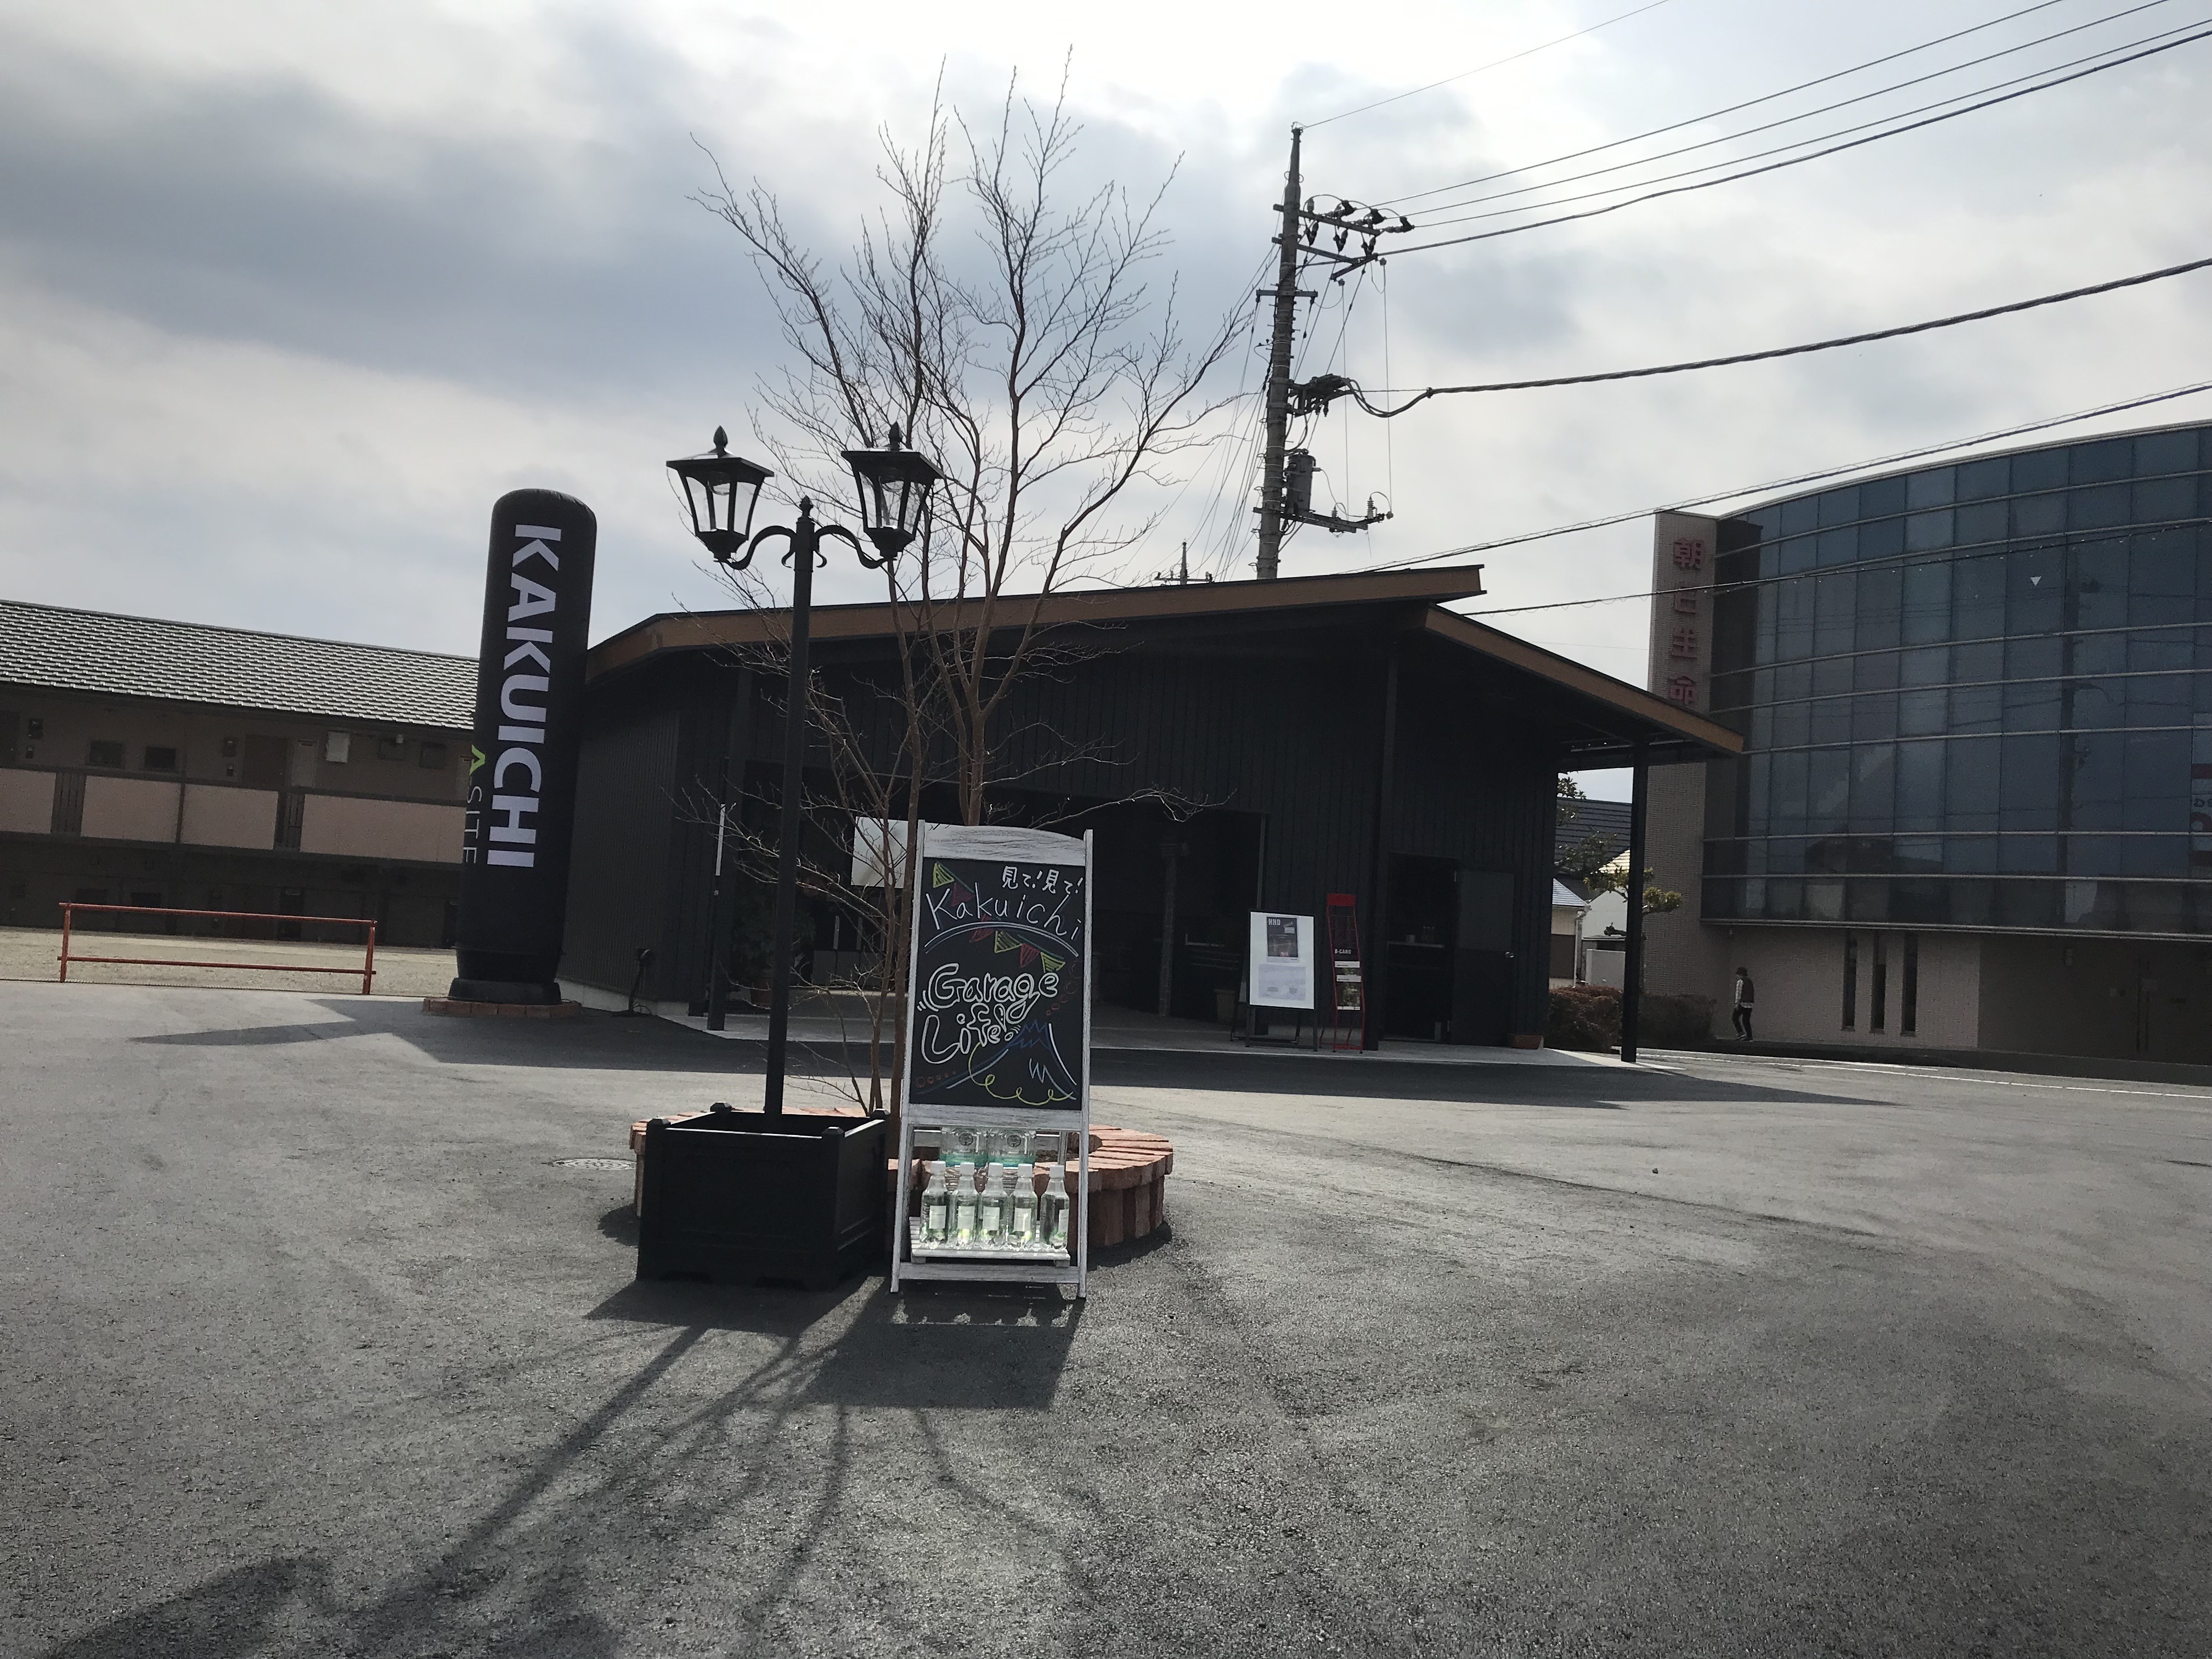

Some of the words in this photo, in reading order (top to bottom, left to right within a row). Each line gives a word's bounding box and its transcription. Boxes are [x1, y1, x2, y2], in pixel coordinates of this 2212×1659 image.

[1669, 539, 1705, 705] 朝日生命
[487, 524, 562, 867] KAKUICHI
[926, 882, 1082, 940] Kakuichi
[928, 962, 1059, 1025] Garage
